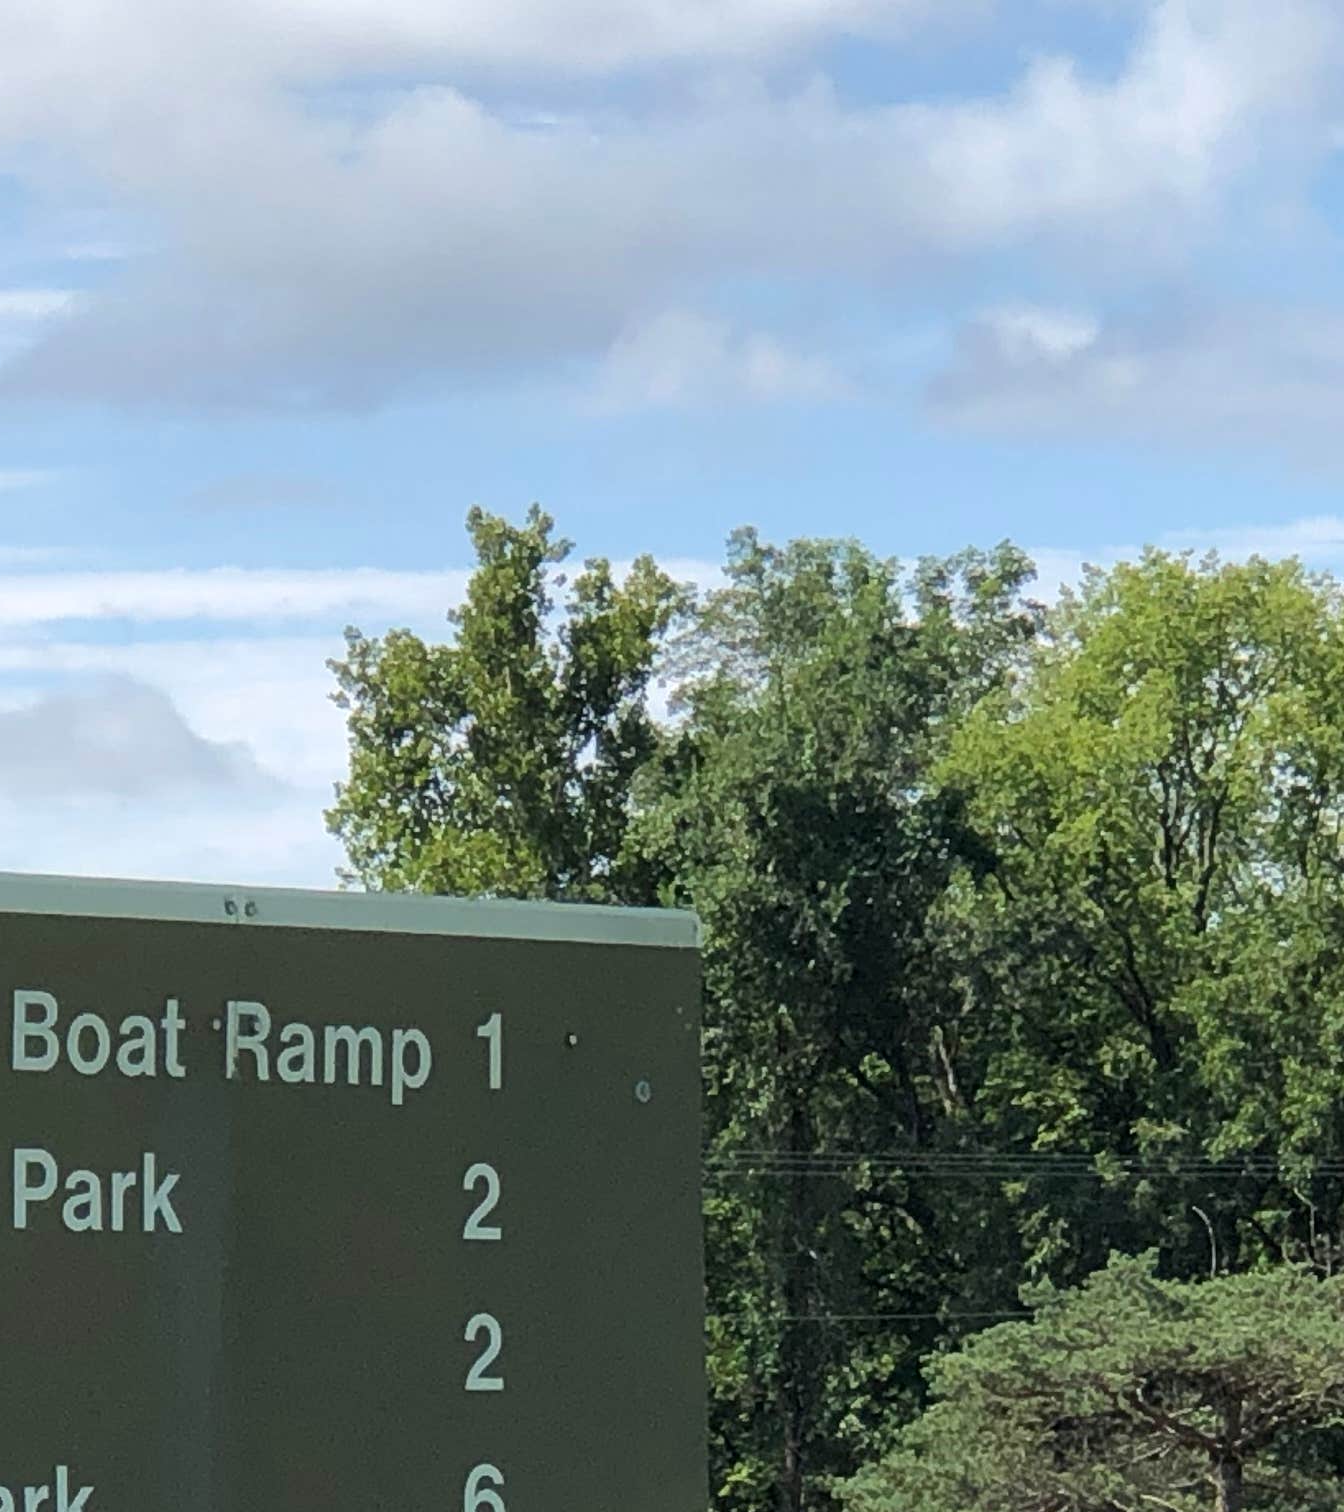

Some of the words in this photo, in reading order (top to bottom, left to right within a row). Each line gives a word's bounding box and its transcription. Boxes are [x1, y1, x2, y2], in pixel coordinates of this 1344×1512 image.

[12, 989, 186, 1078] Boat
[225, 1000, 432, 1105] Ramp
[476, 1013, 502, 1089] 1
[13, 1148, 183, 1233] Park
[462, 1162, 502, 1240] 2
[464, 1312, 505, 1391] 2
